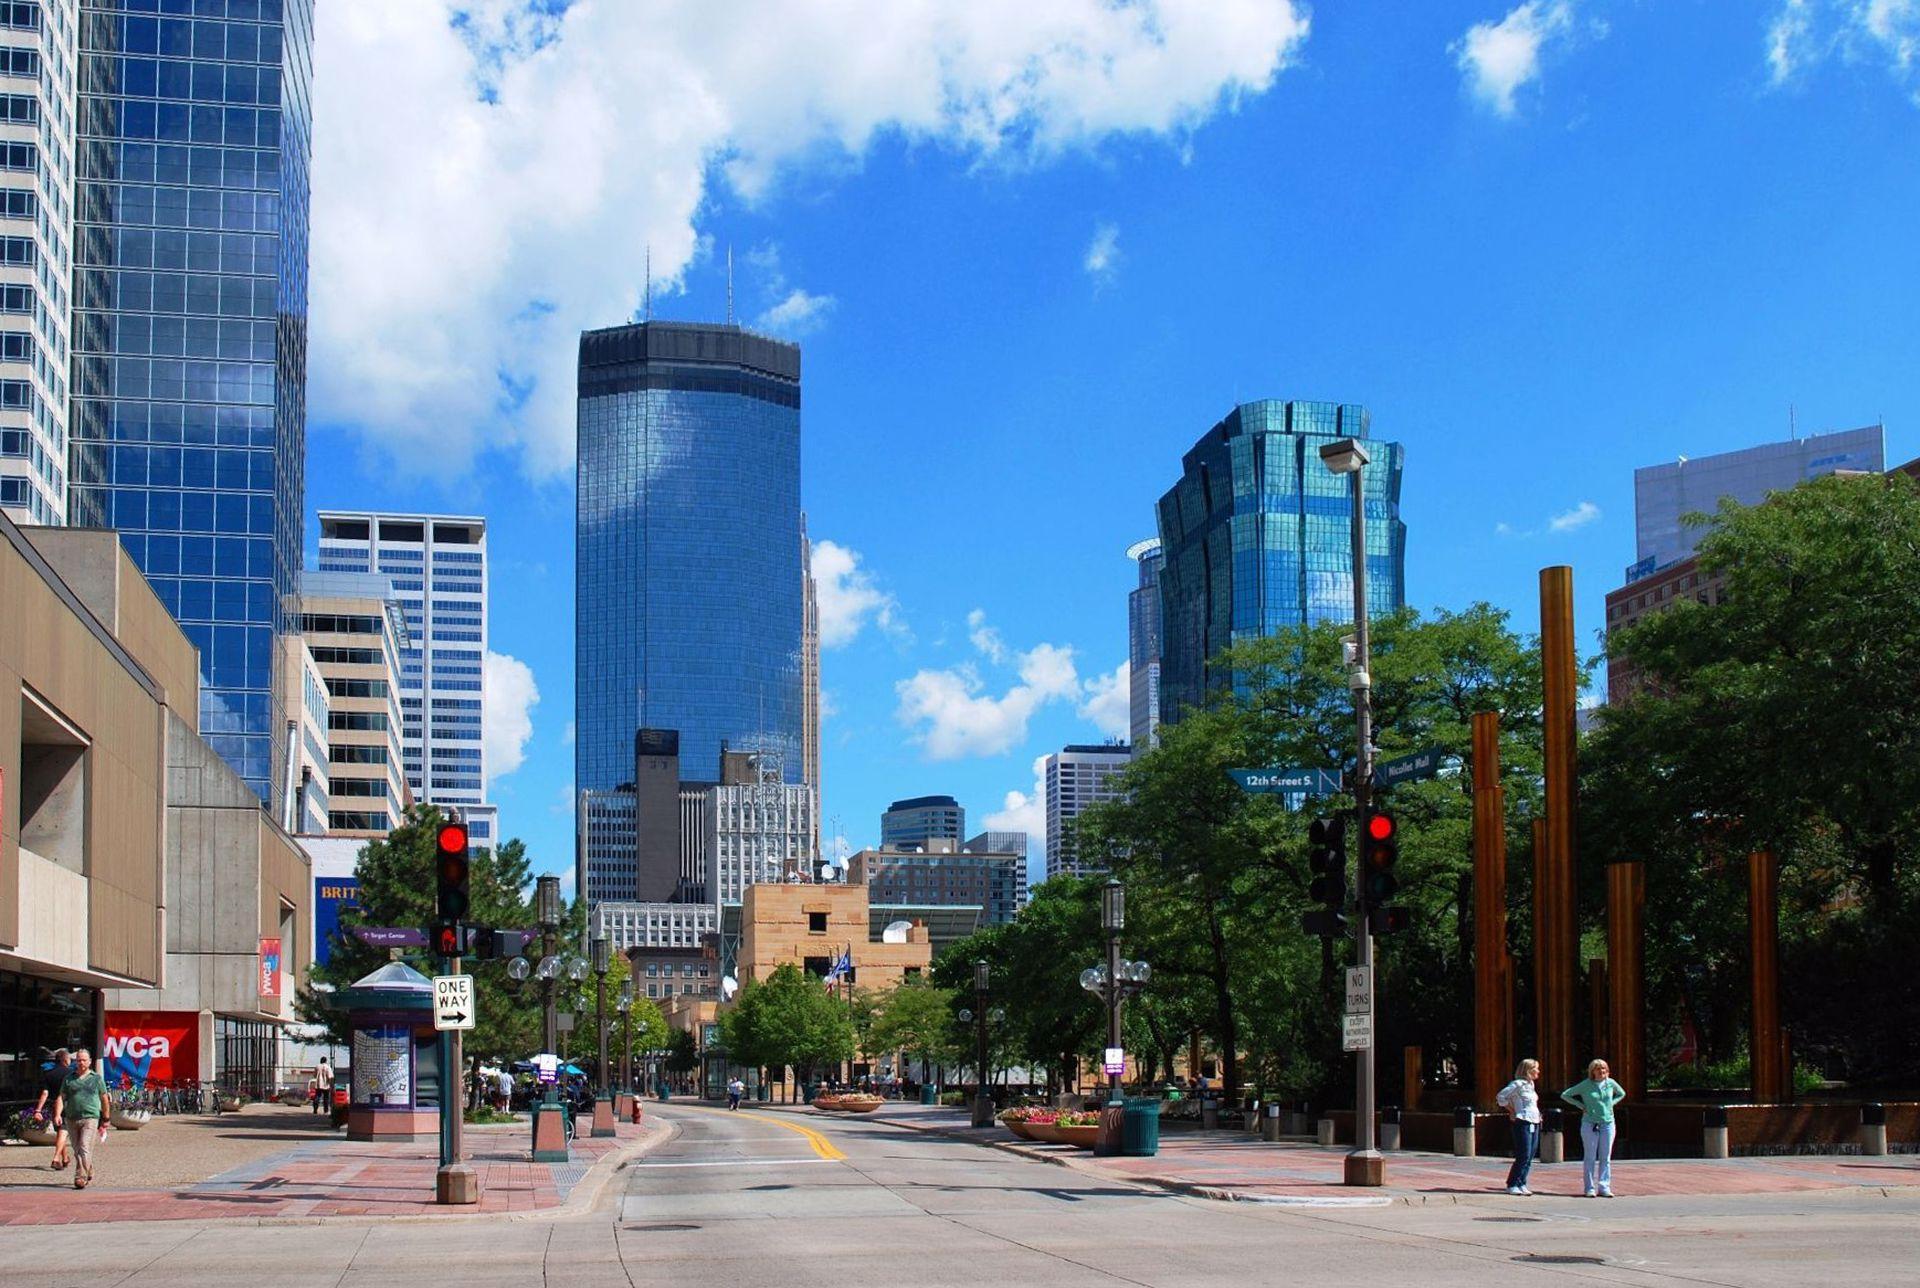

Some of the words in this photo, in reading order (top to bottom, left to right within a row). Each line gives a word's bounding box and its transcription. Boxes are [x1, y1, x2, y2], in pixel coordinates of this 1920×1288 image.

[1388, 761, 1414, 778] Nicollet
[1415, 754, 1430, 770] Mall
[1246, 775, 1269, 786] 12th
[1270, 775, 1302, 786] Street
[263, 961, 274, 995] ywca
[1352, 973, 1364, 987] NO
[439, 980, 467, 993] ONE
[438, 995, 469, 1008] WAY
[1347, 993, 1369, 1006] TURNS
